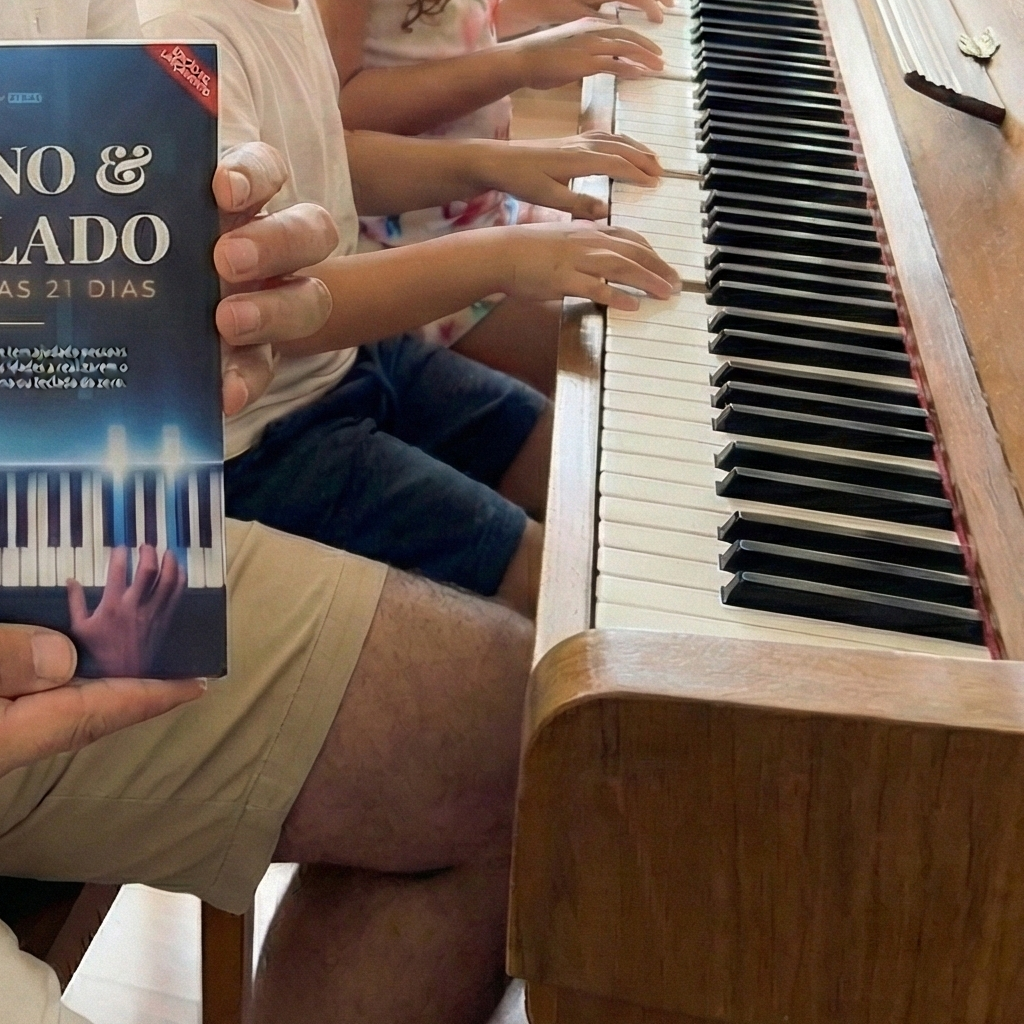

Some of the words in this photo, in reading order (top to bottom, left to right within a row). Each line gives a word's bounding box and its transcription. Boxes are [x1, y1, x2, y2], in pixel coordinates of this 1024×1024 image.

[96, 145, 152, 193] &
[47, 280, 71, 298] 21
[89, 280, 156, 298] DIAS
